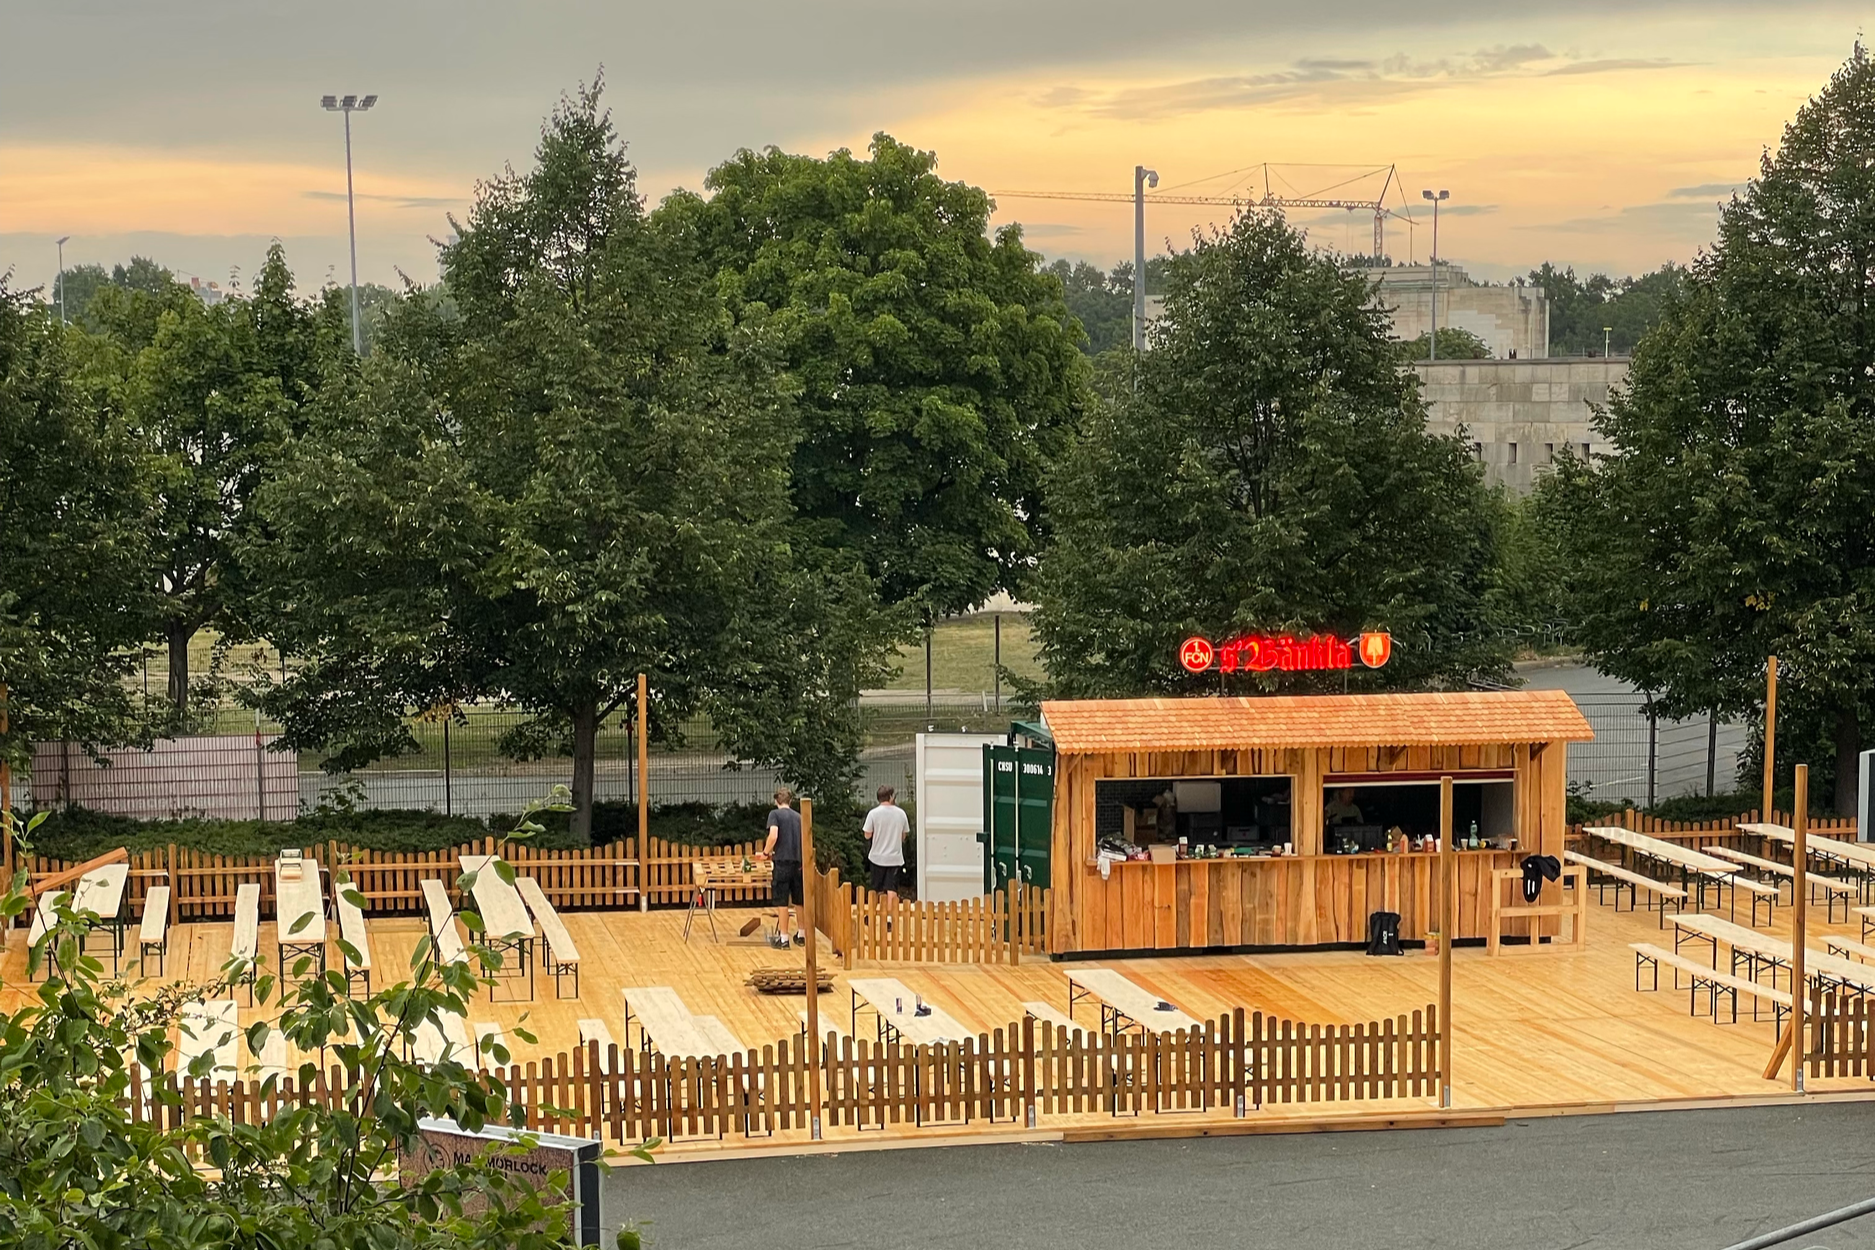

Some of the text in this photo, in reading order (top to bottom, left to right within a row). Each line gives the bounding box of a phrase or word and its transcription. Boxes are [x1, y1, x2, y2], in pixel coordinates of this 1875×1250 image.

[1193, 641, 1201, 652] 1.
[1185, 652, 1209, 663] FCN
[1047, 765, 1052, 776] 3
[485, 1157, 548, 1175] MORLOCK
